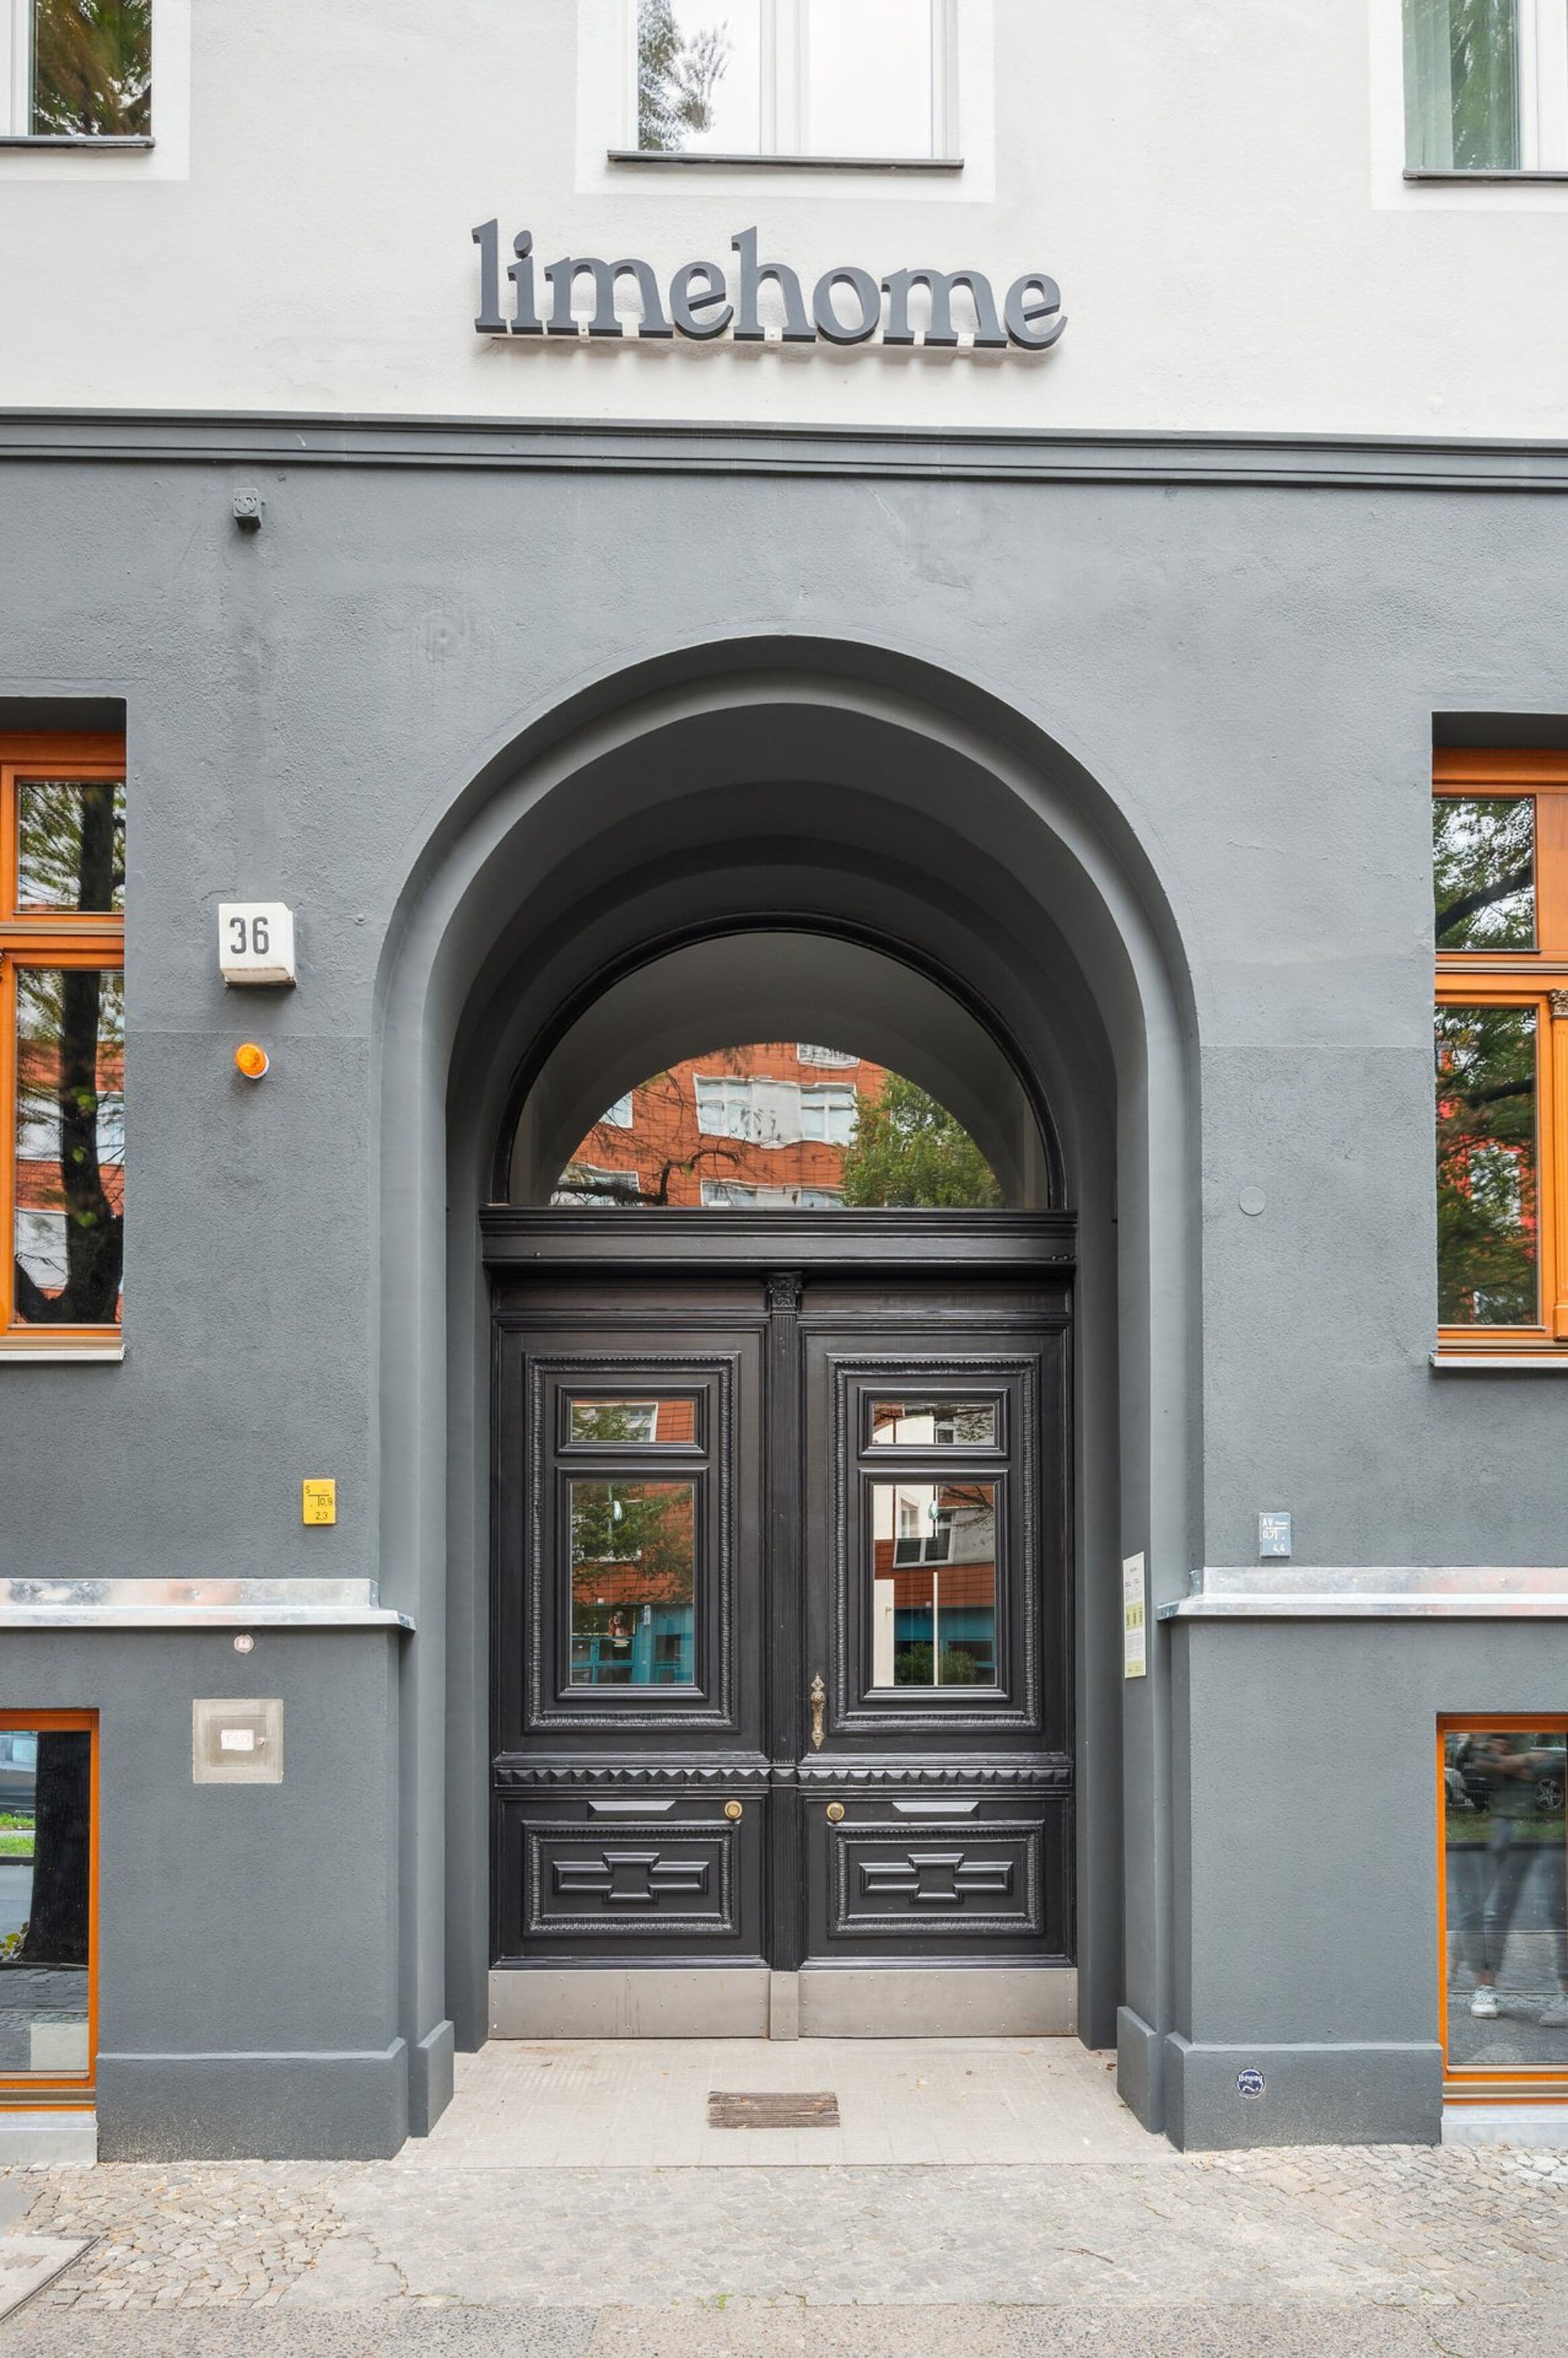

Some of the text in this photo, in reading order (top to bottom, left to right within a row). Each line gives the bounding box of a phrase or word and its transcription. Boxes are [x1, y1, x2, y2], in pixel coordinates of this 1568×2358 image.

[471, 218, 1068, 350] limehome
[229, 916, 269, 954] 36
[305, 1486, 311, 1494] S
[1262, 1517, 1274, 1527] AV
